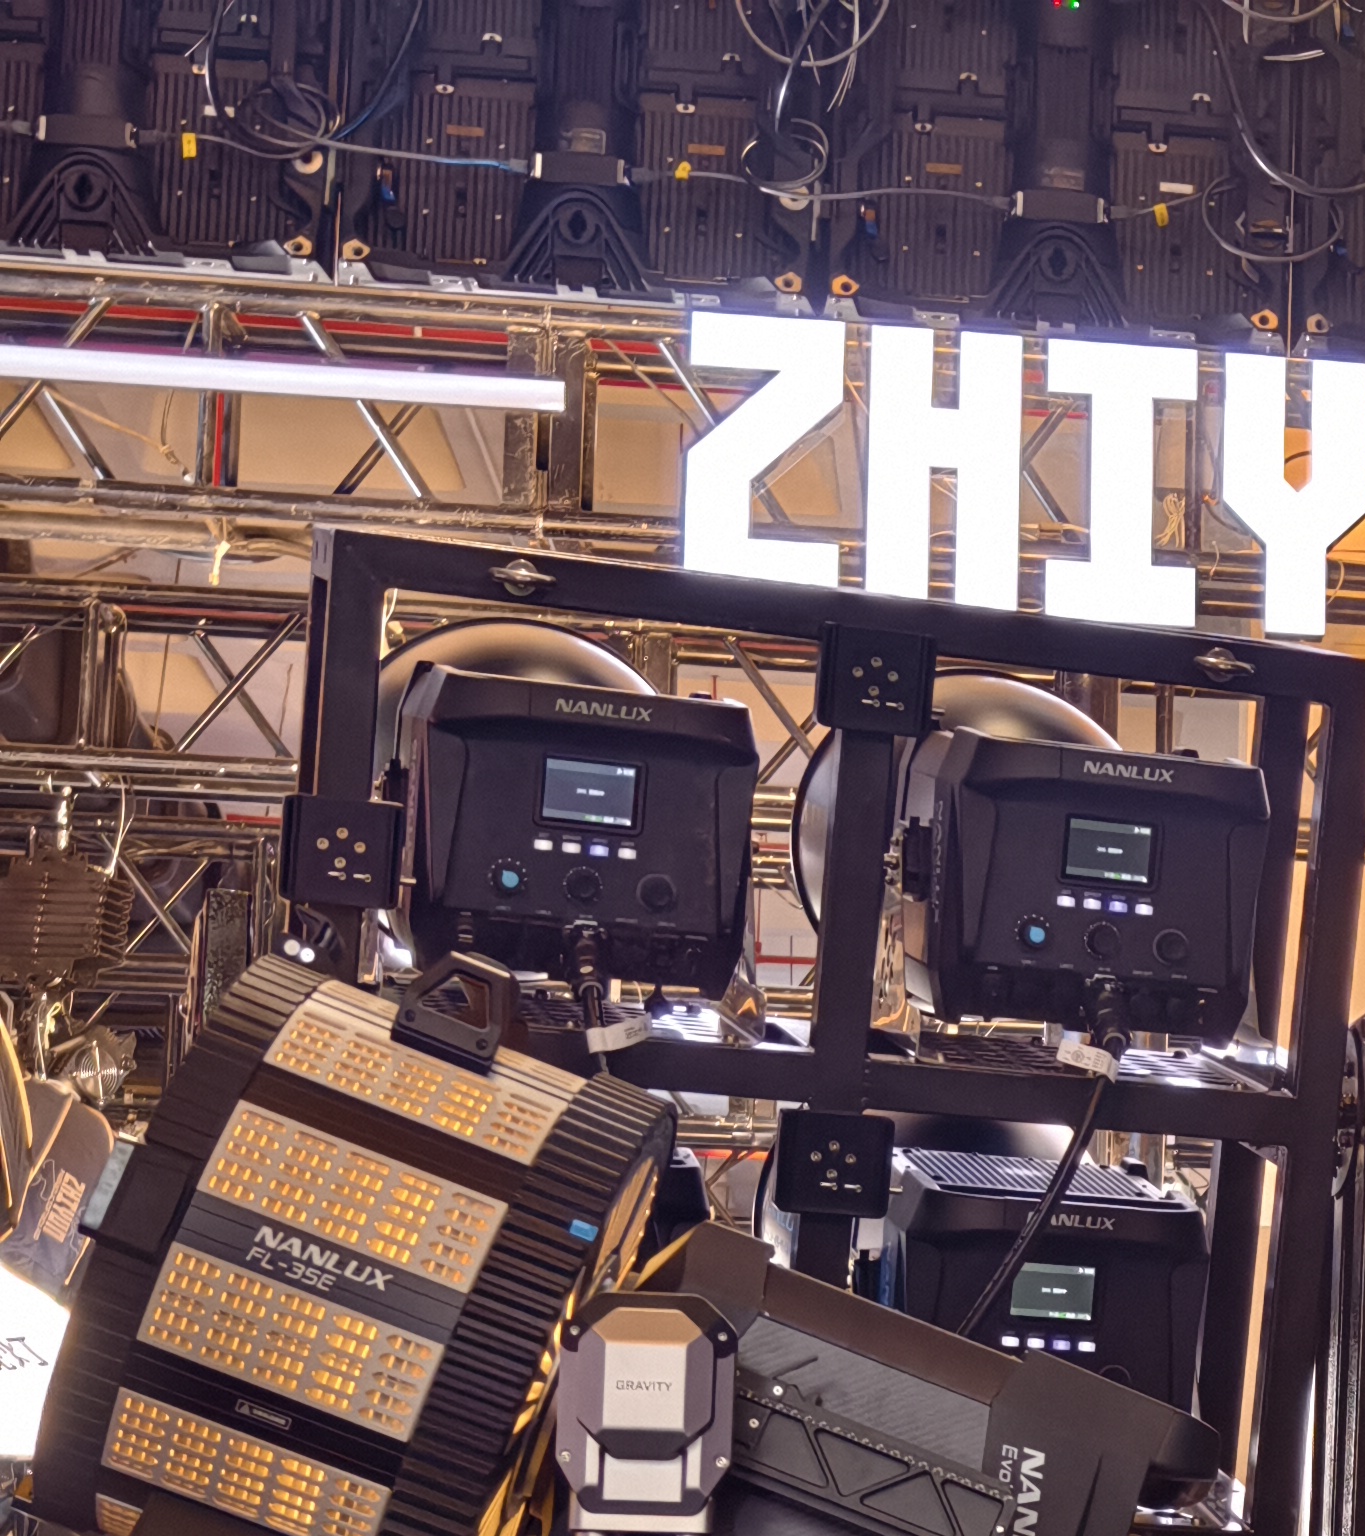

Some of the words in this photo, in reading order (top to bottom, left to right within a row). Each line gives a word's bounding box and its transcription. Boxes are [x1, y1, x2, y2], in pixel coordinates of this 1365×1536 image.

[555, 698, 653, 722] NANLUX
[1083, 760, 1175, 783] NANLUX
[1027, 1211, 1116, 1231] NLUX
[245, 1246, 337, 1292] FL-35E
[253, 1225, 394, 1292] NANLUX
[615, 1379, 673, 1391] GRAVITY
